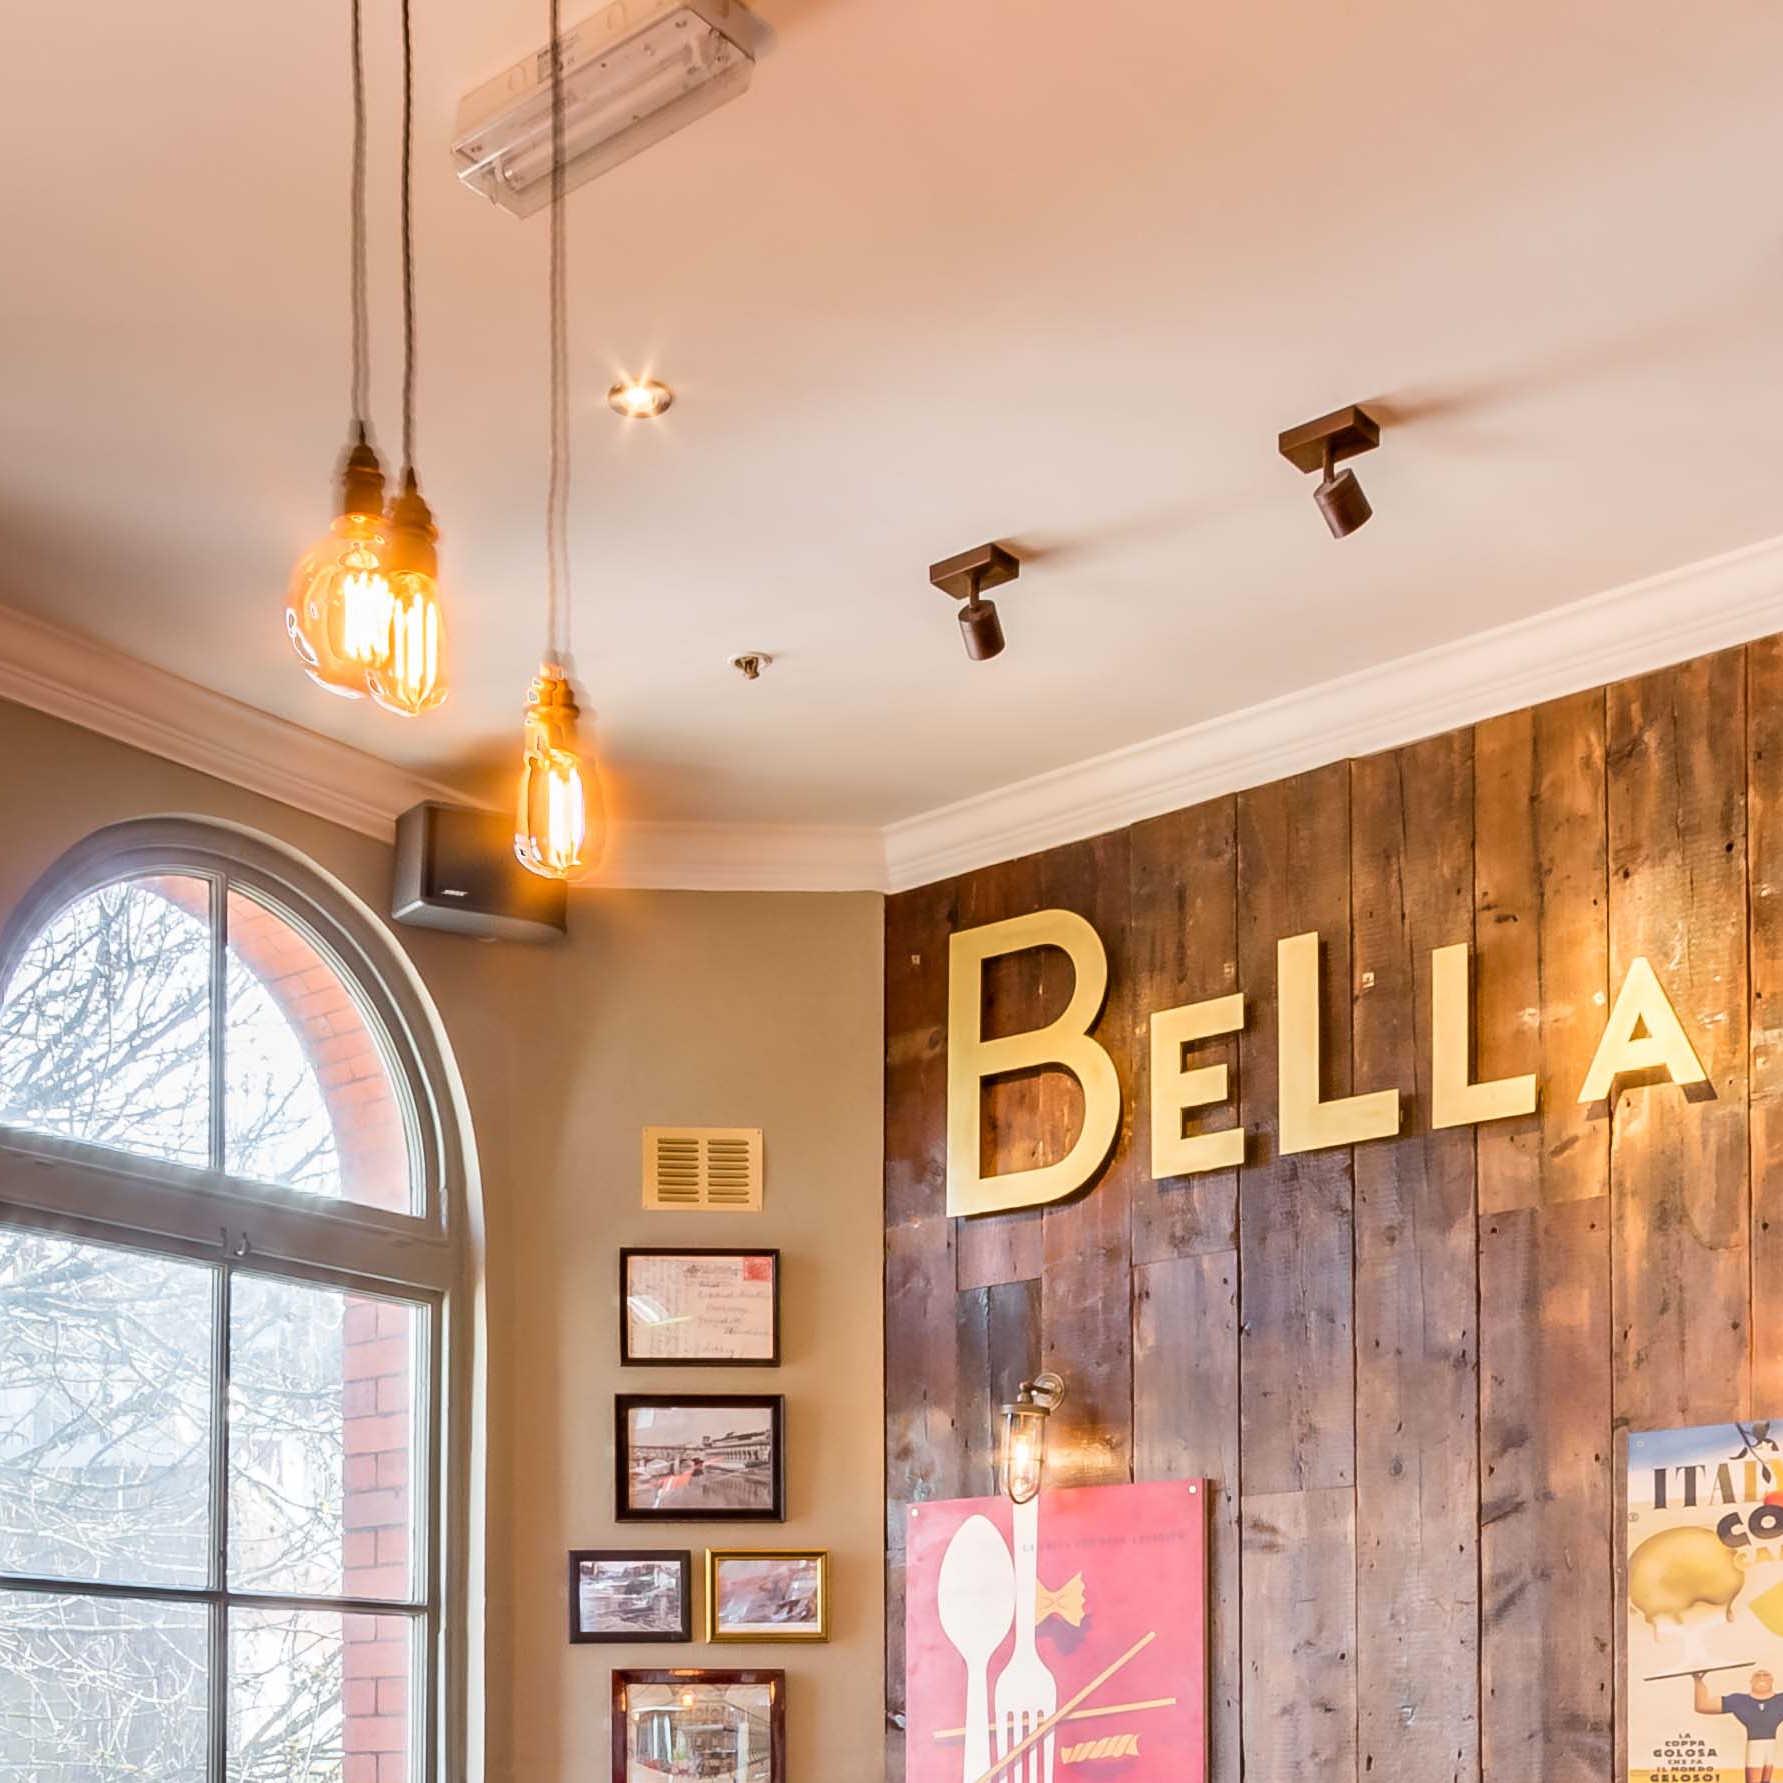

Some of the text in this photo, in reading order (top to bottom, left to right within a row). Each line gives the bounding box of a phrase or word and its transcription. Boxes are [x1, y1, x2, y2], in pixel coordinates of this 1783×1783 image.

[947, 908, 1711, 1217] BELLA
[1653, 1749, 1717, 1758] GOLOSA
[1650, 1774, 1720, 1783] GELOSO!
